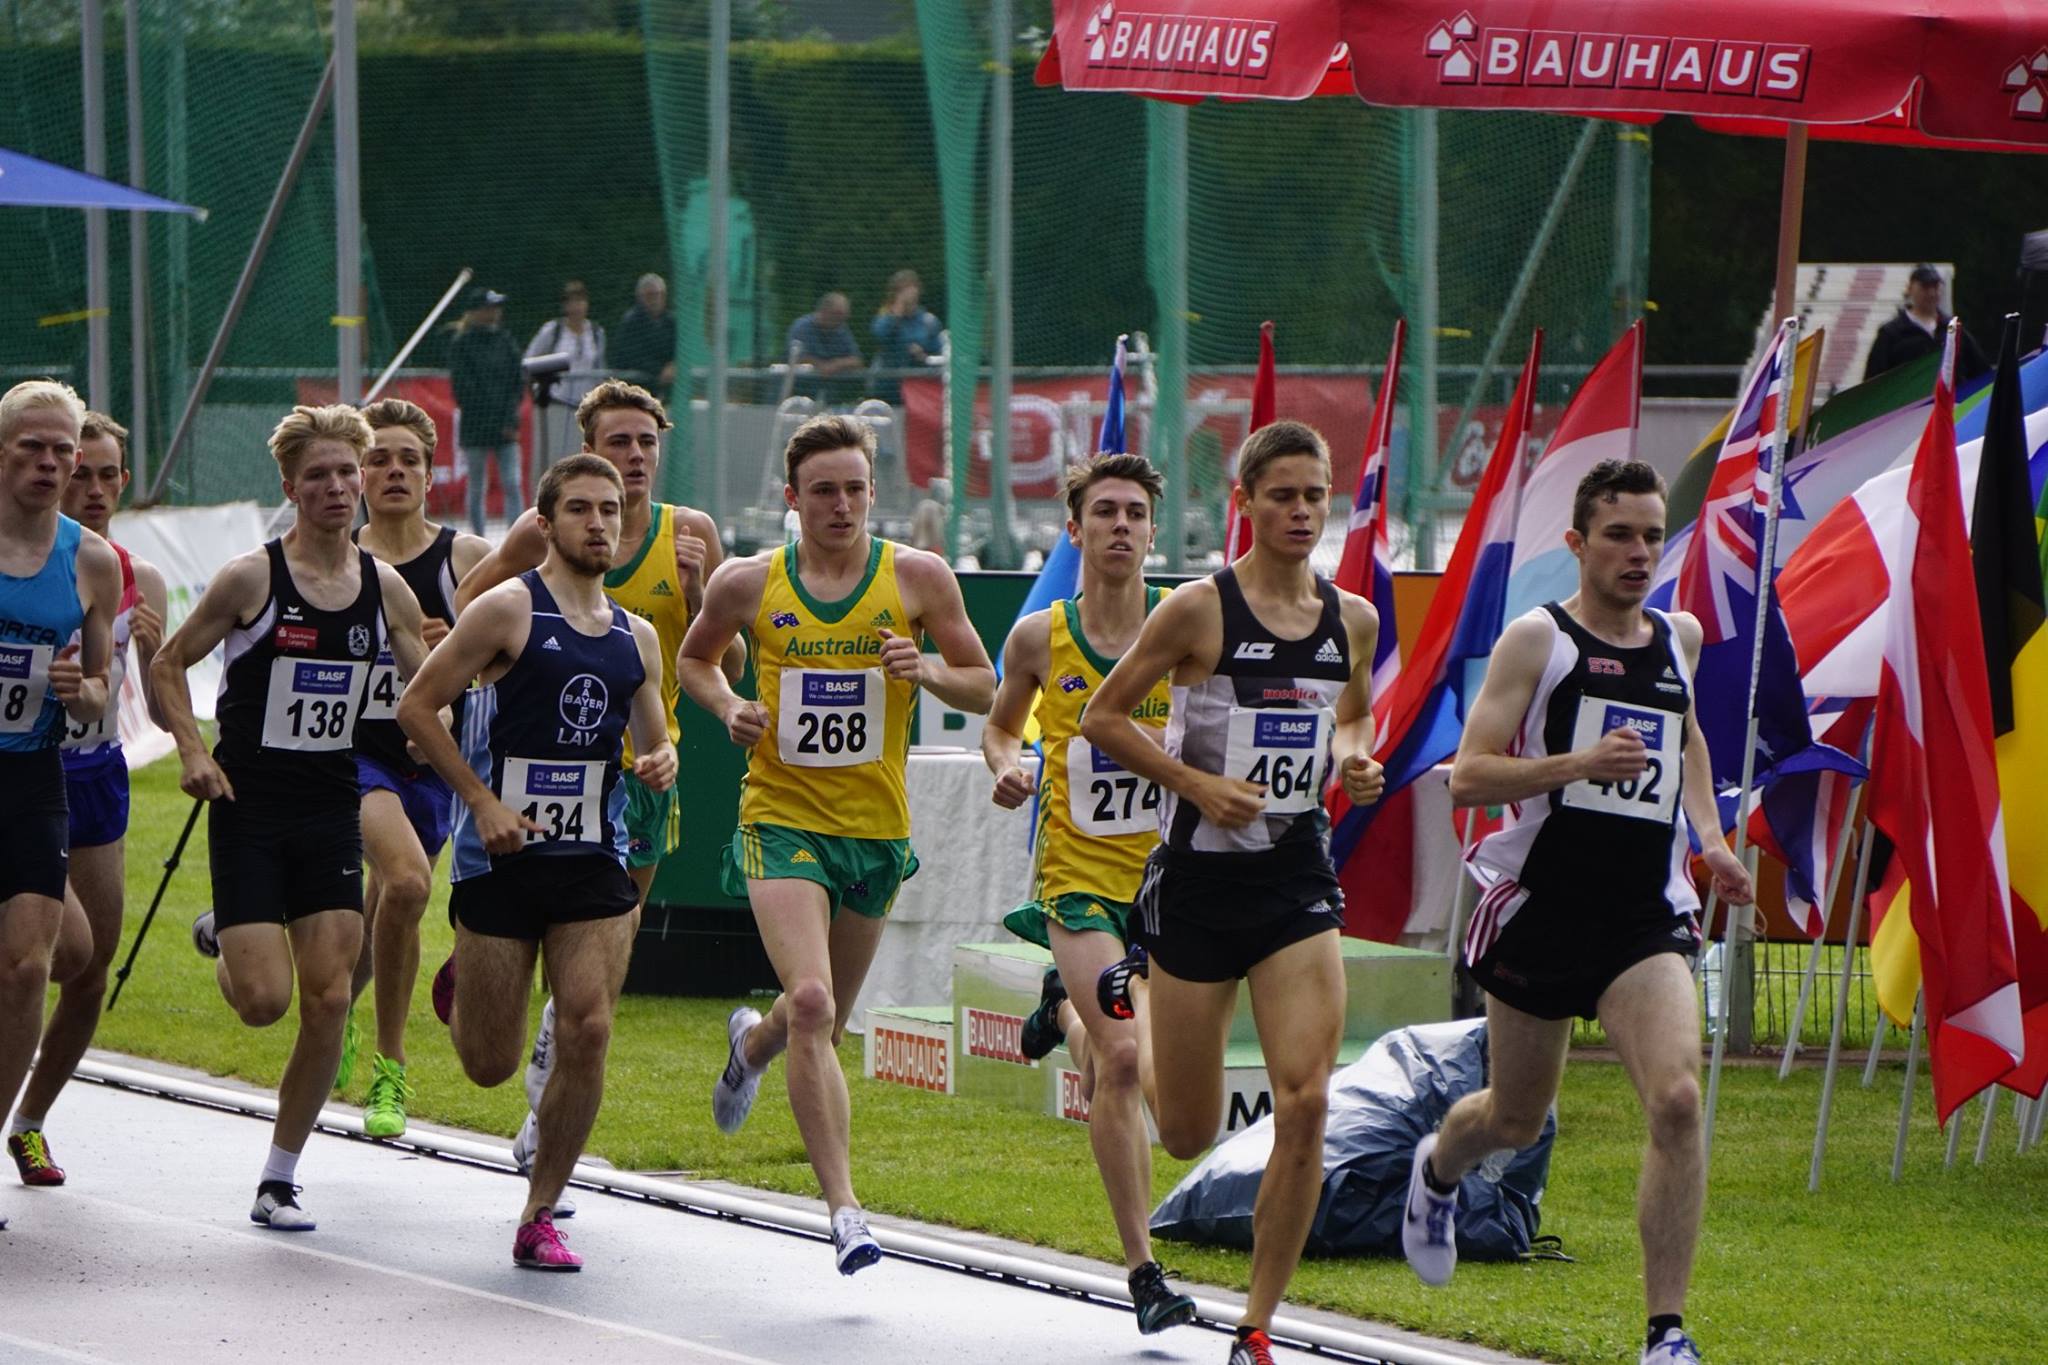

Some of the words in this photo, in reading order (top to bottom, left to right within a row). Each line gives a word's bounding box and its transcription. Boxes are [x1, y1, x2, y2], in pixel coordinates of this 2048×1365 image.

[1110, 20, 1271, 69] BAUHAUS
[1487, 36, 1802, 90] BAUHAUS
[785, 635, 881, 657] Australia
[1315, 653, 1343, 663] adidas
[317, 670, 347, 682] BASF
[826, 681, 859, 692] BASF
[564, 693, 604, 711] BAYER
[287, 698, 348, 739] 138
[797, 711, 867, 755] 268
[1280, 721, 1313, 734] BASF
[1626, 716, 1658, 734] BASF
[557, 727, 599, 747] LAV
[551, 771, 580, 783] BASF
[1245, 754, 1315, 800] 464
[1090, 777, 1162, 822] 274
[521, 801, 584, 842] 134
[969, 1014, 1023, 1056] BAUHAU
[876, 1034, 946, 1085] BAUHAUS
